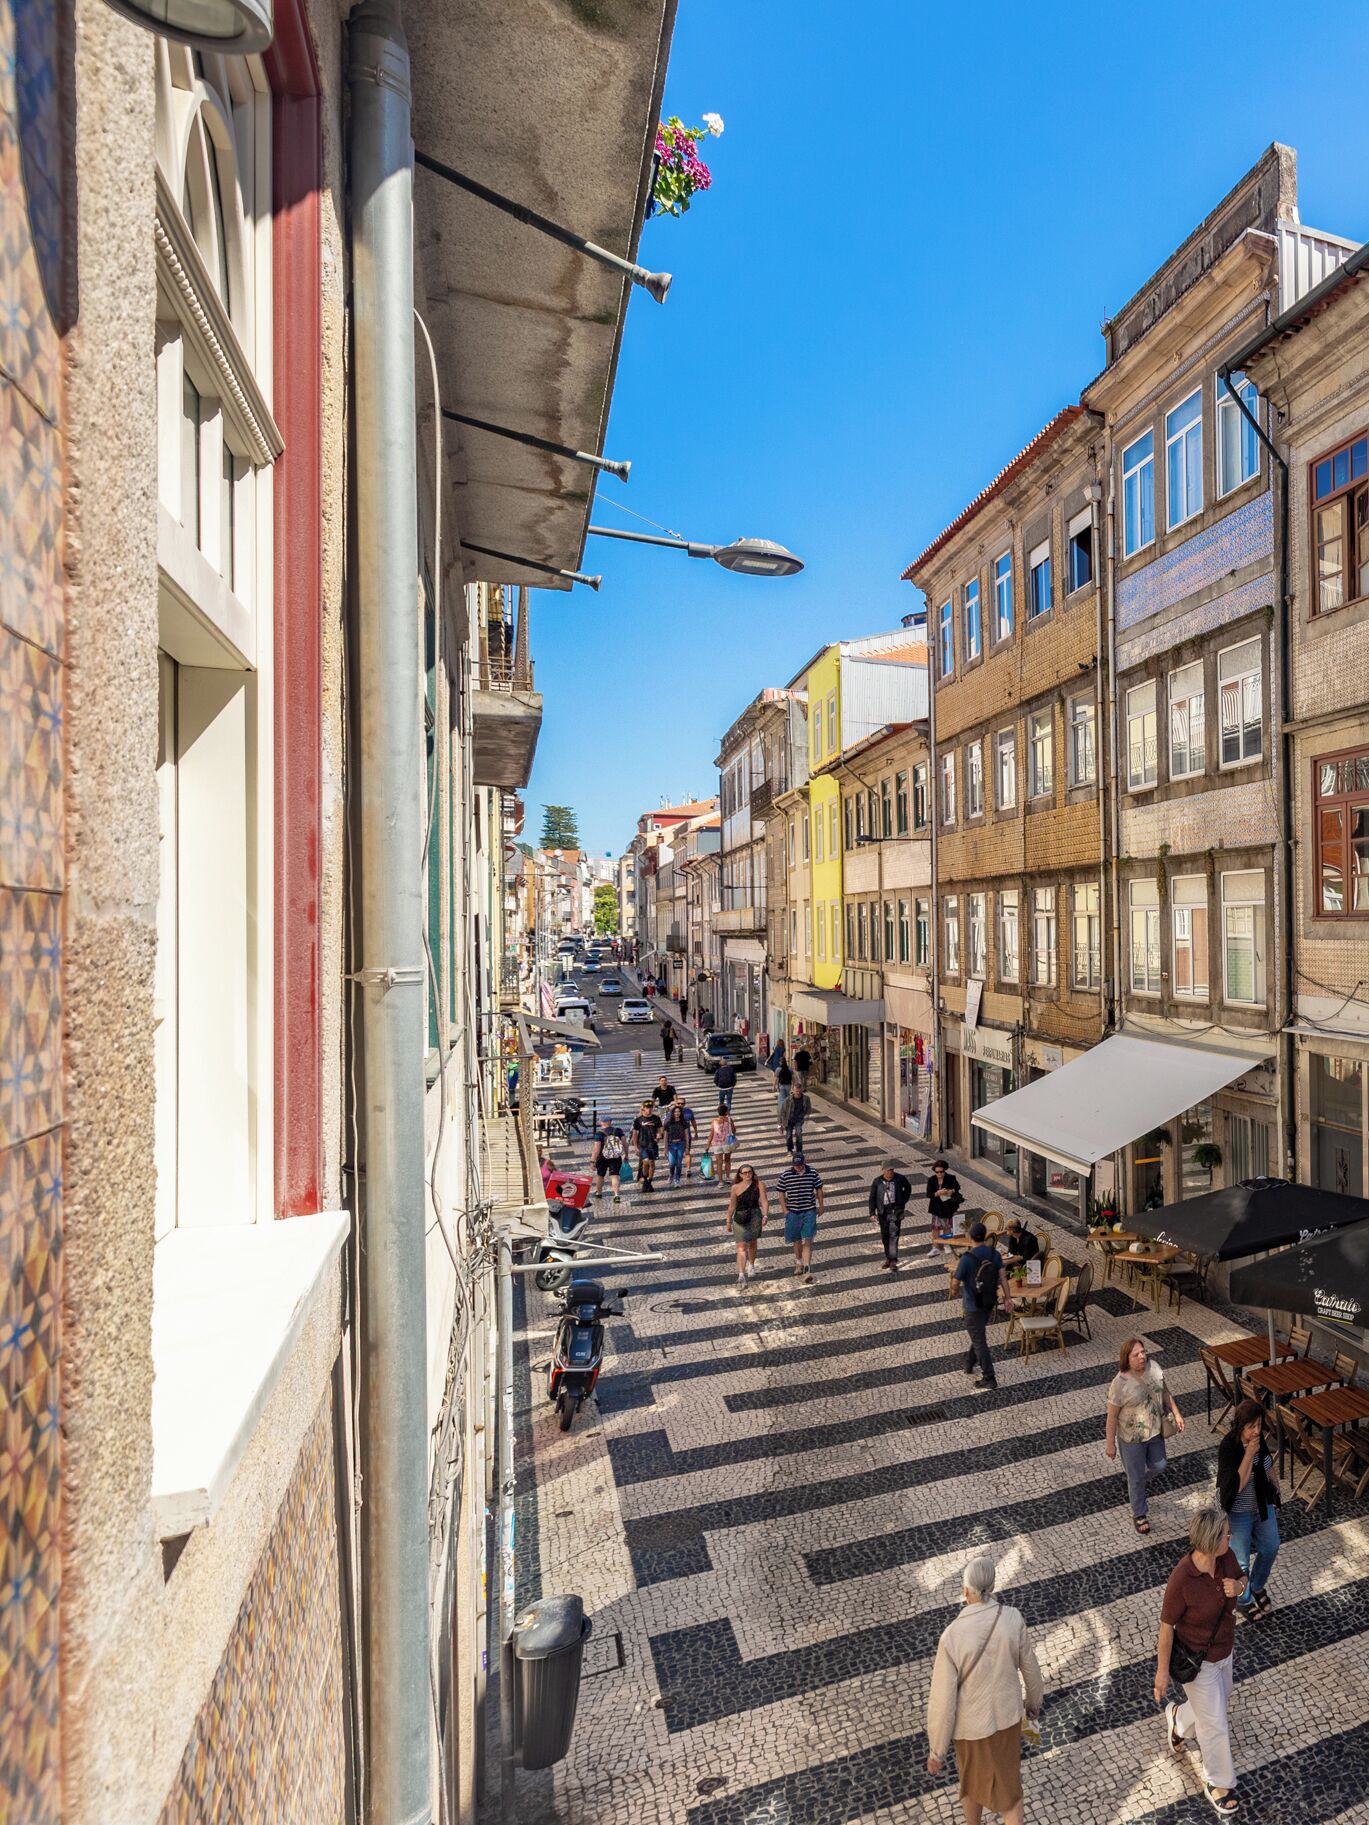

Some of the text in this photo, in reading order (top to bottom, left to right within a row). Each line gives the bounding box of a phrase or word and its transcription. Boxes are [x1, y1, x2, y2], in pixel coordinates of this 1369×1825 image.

[1313, 1288, 1361, 1313] Catraio
[1317, 1306, 1355, 1320] CRAFT BEER SHOP
